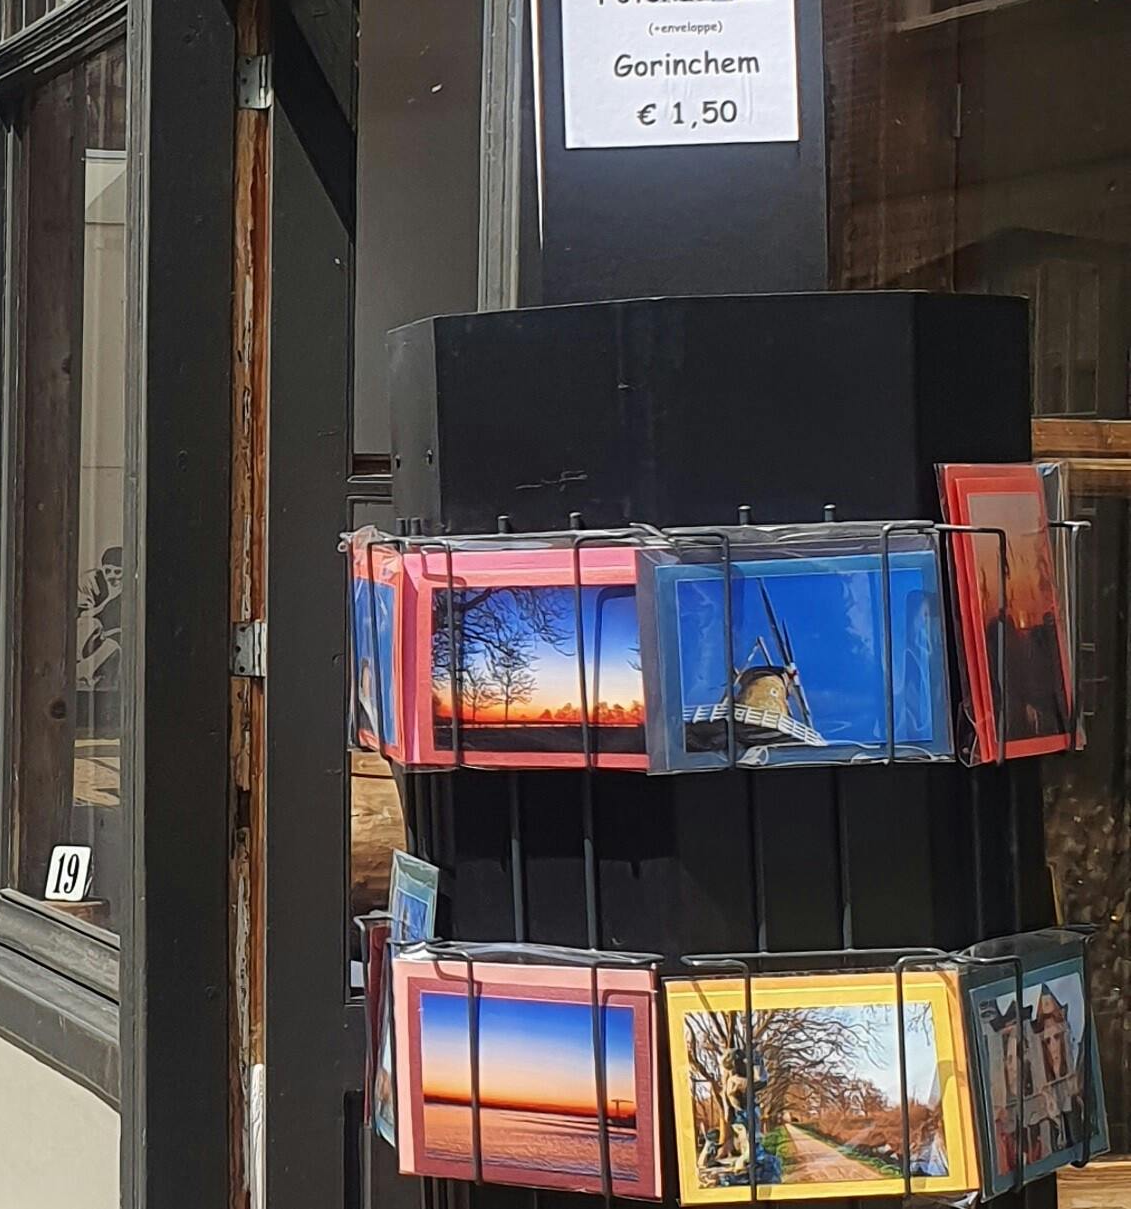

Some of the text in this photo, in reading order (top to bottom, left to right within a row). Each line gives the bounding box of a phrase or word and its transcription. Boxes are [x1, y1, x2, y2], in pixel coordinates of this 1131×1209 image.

[614, 50, 760, 78] Gorinchem
[636, 100, 738, 129] € 1,50
[53, 853, 80, 894] 19
